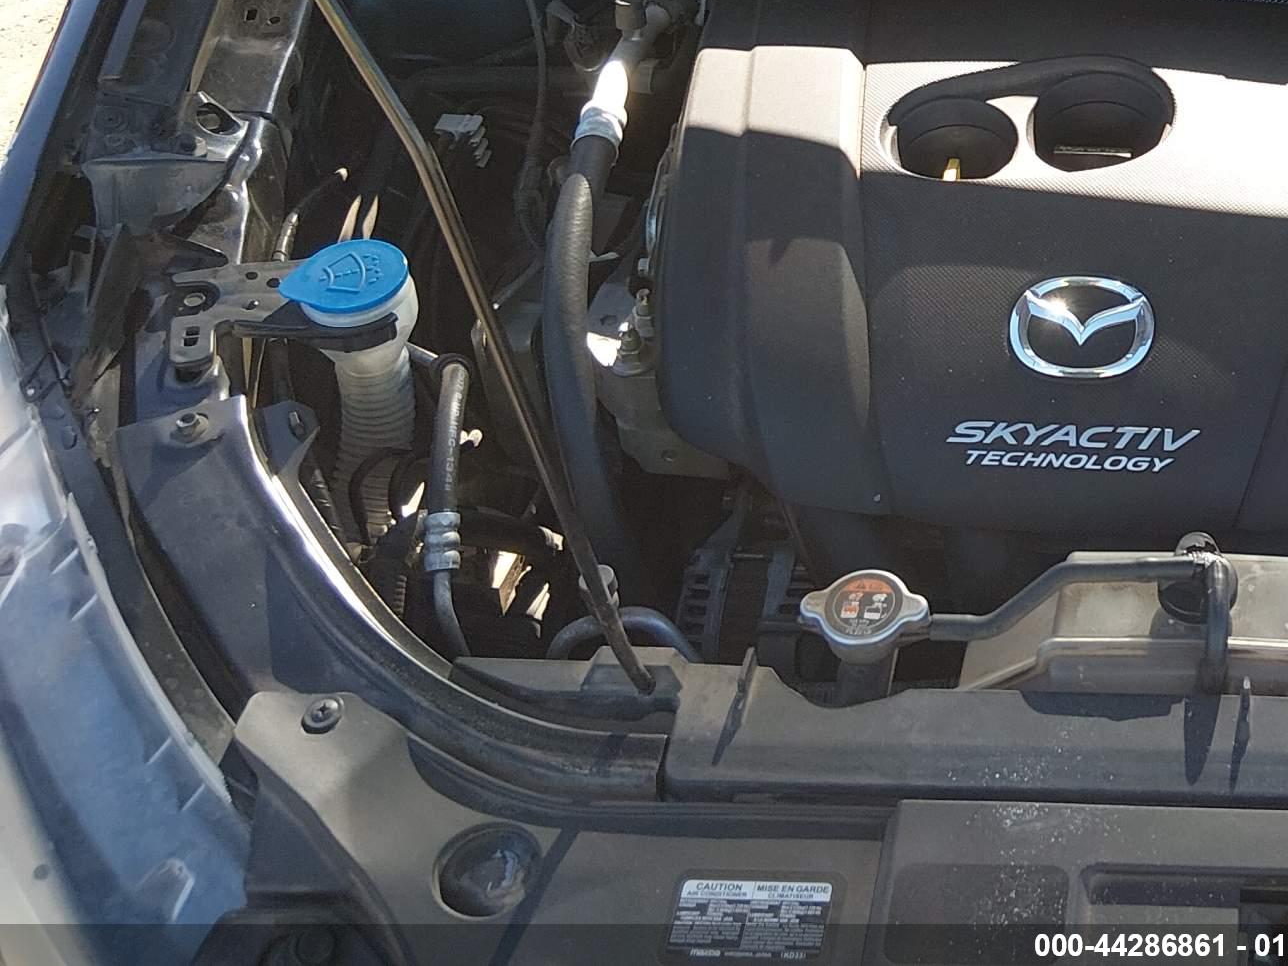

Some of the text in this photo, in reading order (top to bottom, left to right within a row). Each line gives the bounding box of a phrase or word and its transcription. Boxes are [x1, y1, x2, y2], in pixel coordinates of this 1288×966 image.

[946, 420, 1201, 452] SKYACTIV
[965, 449, 1175, 472] TECHNOLOGY
[695, 883, 744, 891] CAUTION
[756, 884, 830, 894] MISE EN GARDE
